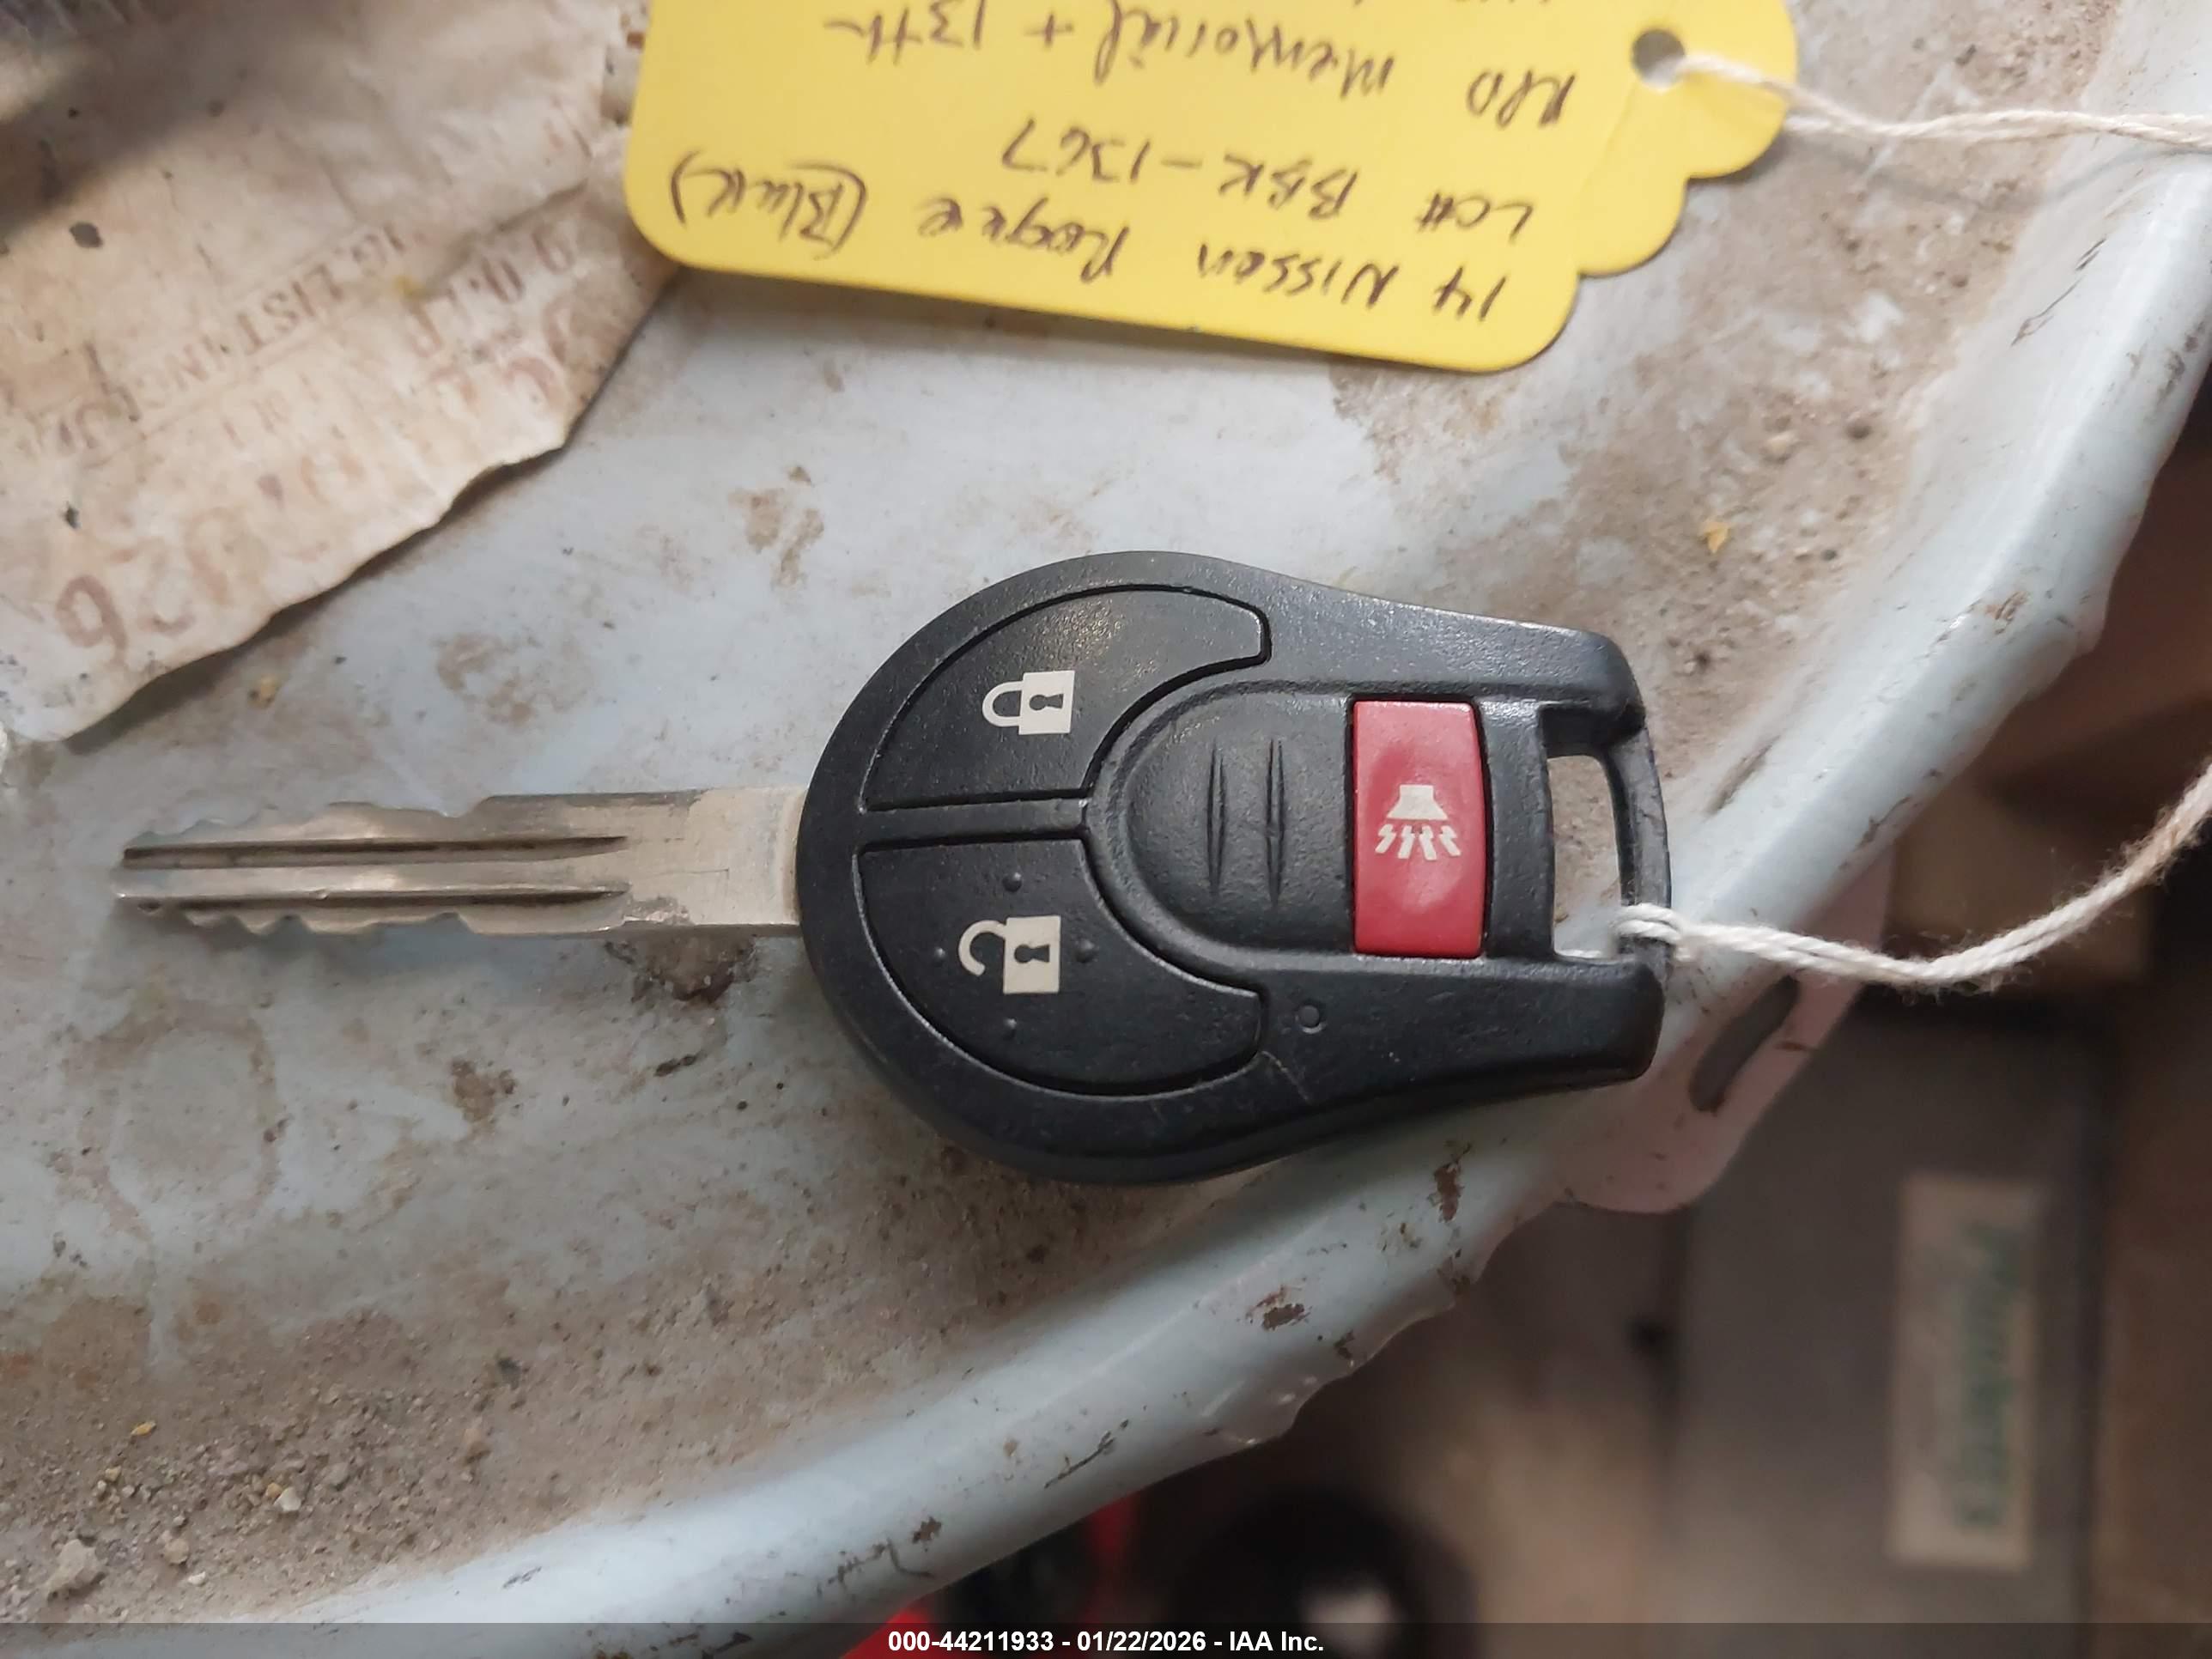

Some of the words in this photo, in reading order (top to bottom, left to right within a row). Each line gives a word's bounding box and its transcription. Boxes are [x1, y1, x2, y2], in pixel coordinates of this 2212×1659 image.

[1092, 0, 1395, 100] Memorial
[1196, 241, 1401, 310] Nissan
[1431, 264, 1508, 322] 14
